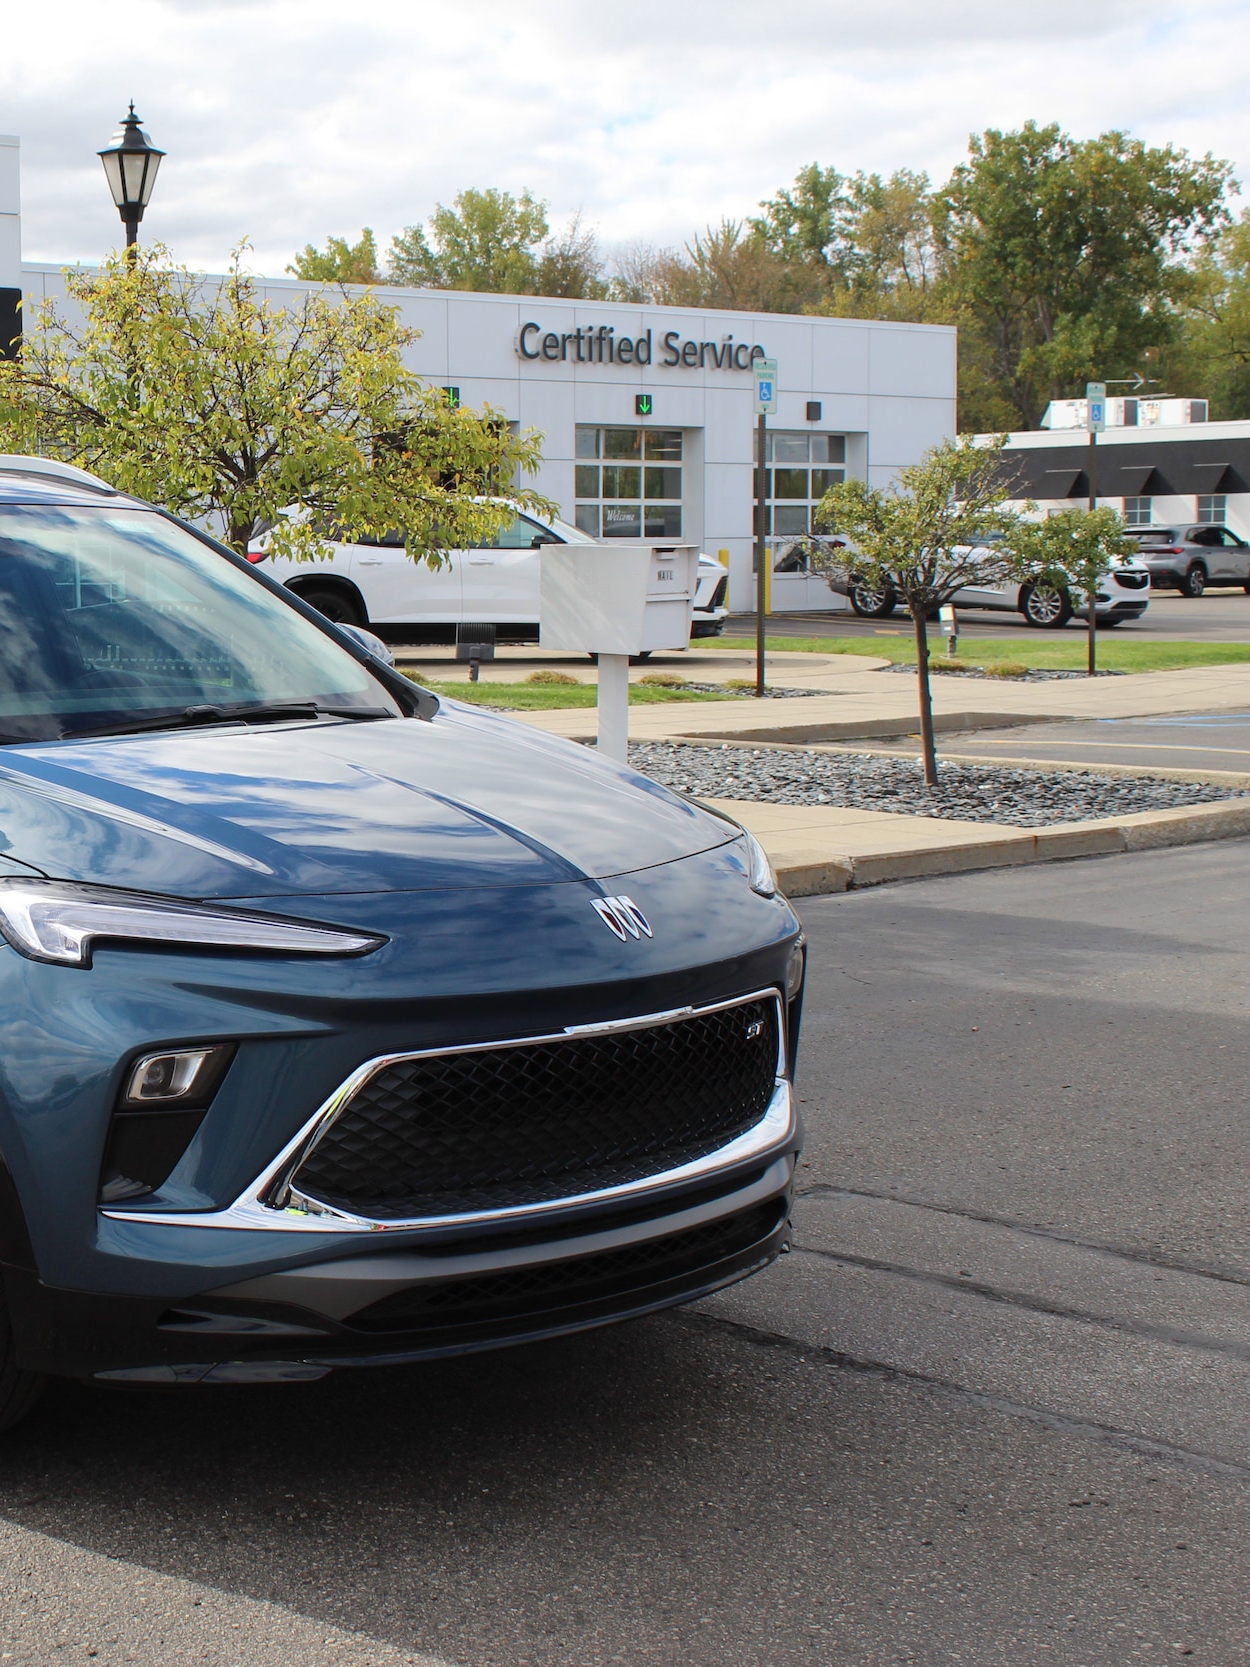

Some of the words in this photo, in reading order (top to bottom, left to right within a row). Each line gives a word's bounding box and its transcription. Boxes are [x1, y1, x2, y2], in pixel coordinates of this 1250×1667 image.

[519, 321, 652, 365] Certified
[663, 331, 765, 370] Service
[606, 509, 636, 521] Welcome
[657, 569, 674, 581] MAIL
[745, 1019, 765, 1040] ST
